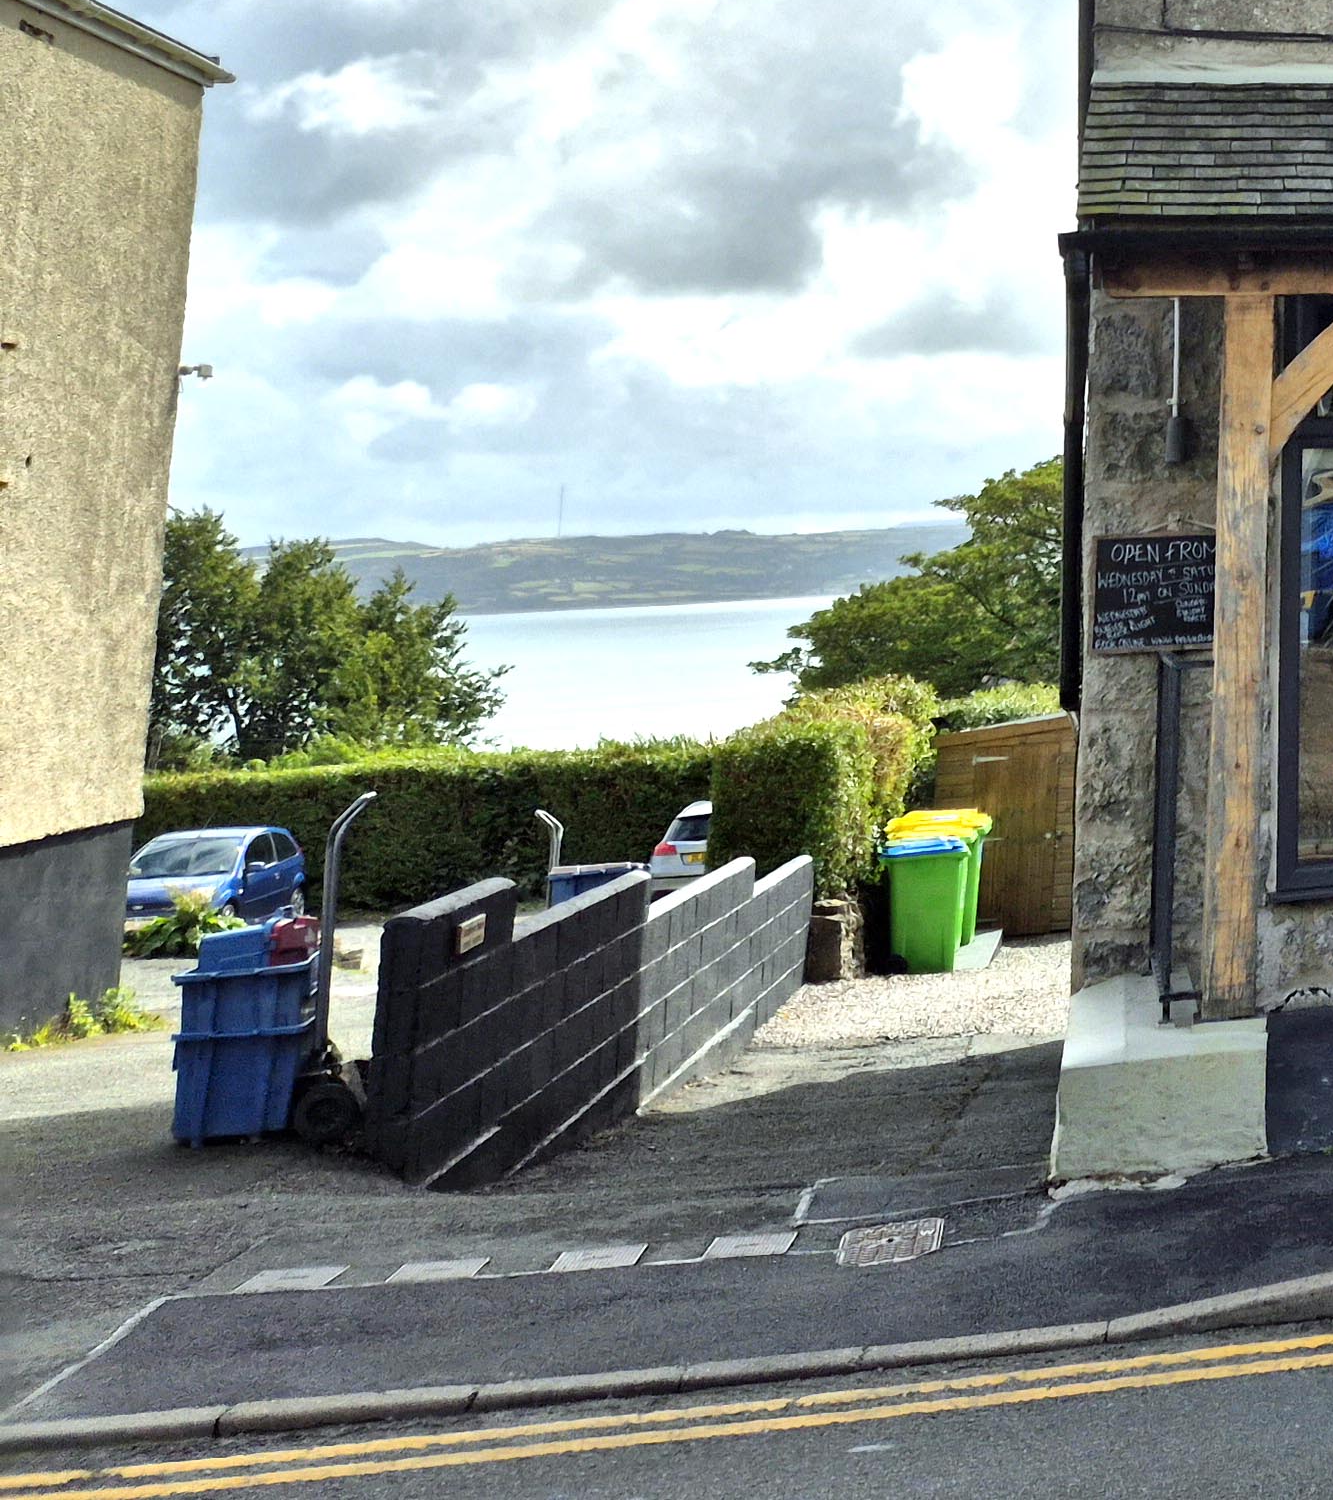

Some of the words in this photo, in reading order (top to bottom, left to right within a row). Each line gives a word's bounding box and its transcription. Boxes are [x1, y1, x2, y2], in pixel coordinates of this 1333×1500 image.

[1110, 543, 1160, 565] OPEN
[1165, 540, 1216, 561] FROM
[1097, 569, 1163, 589] WEDNESDAY
[1183, 565, 1215, 579] SATU
